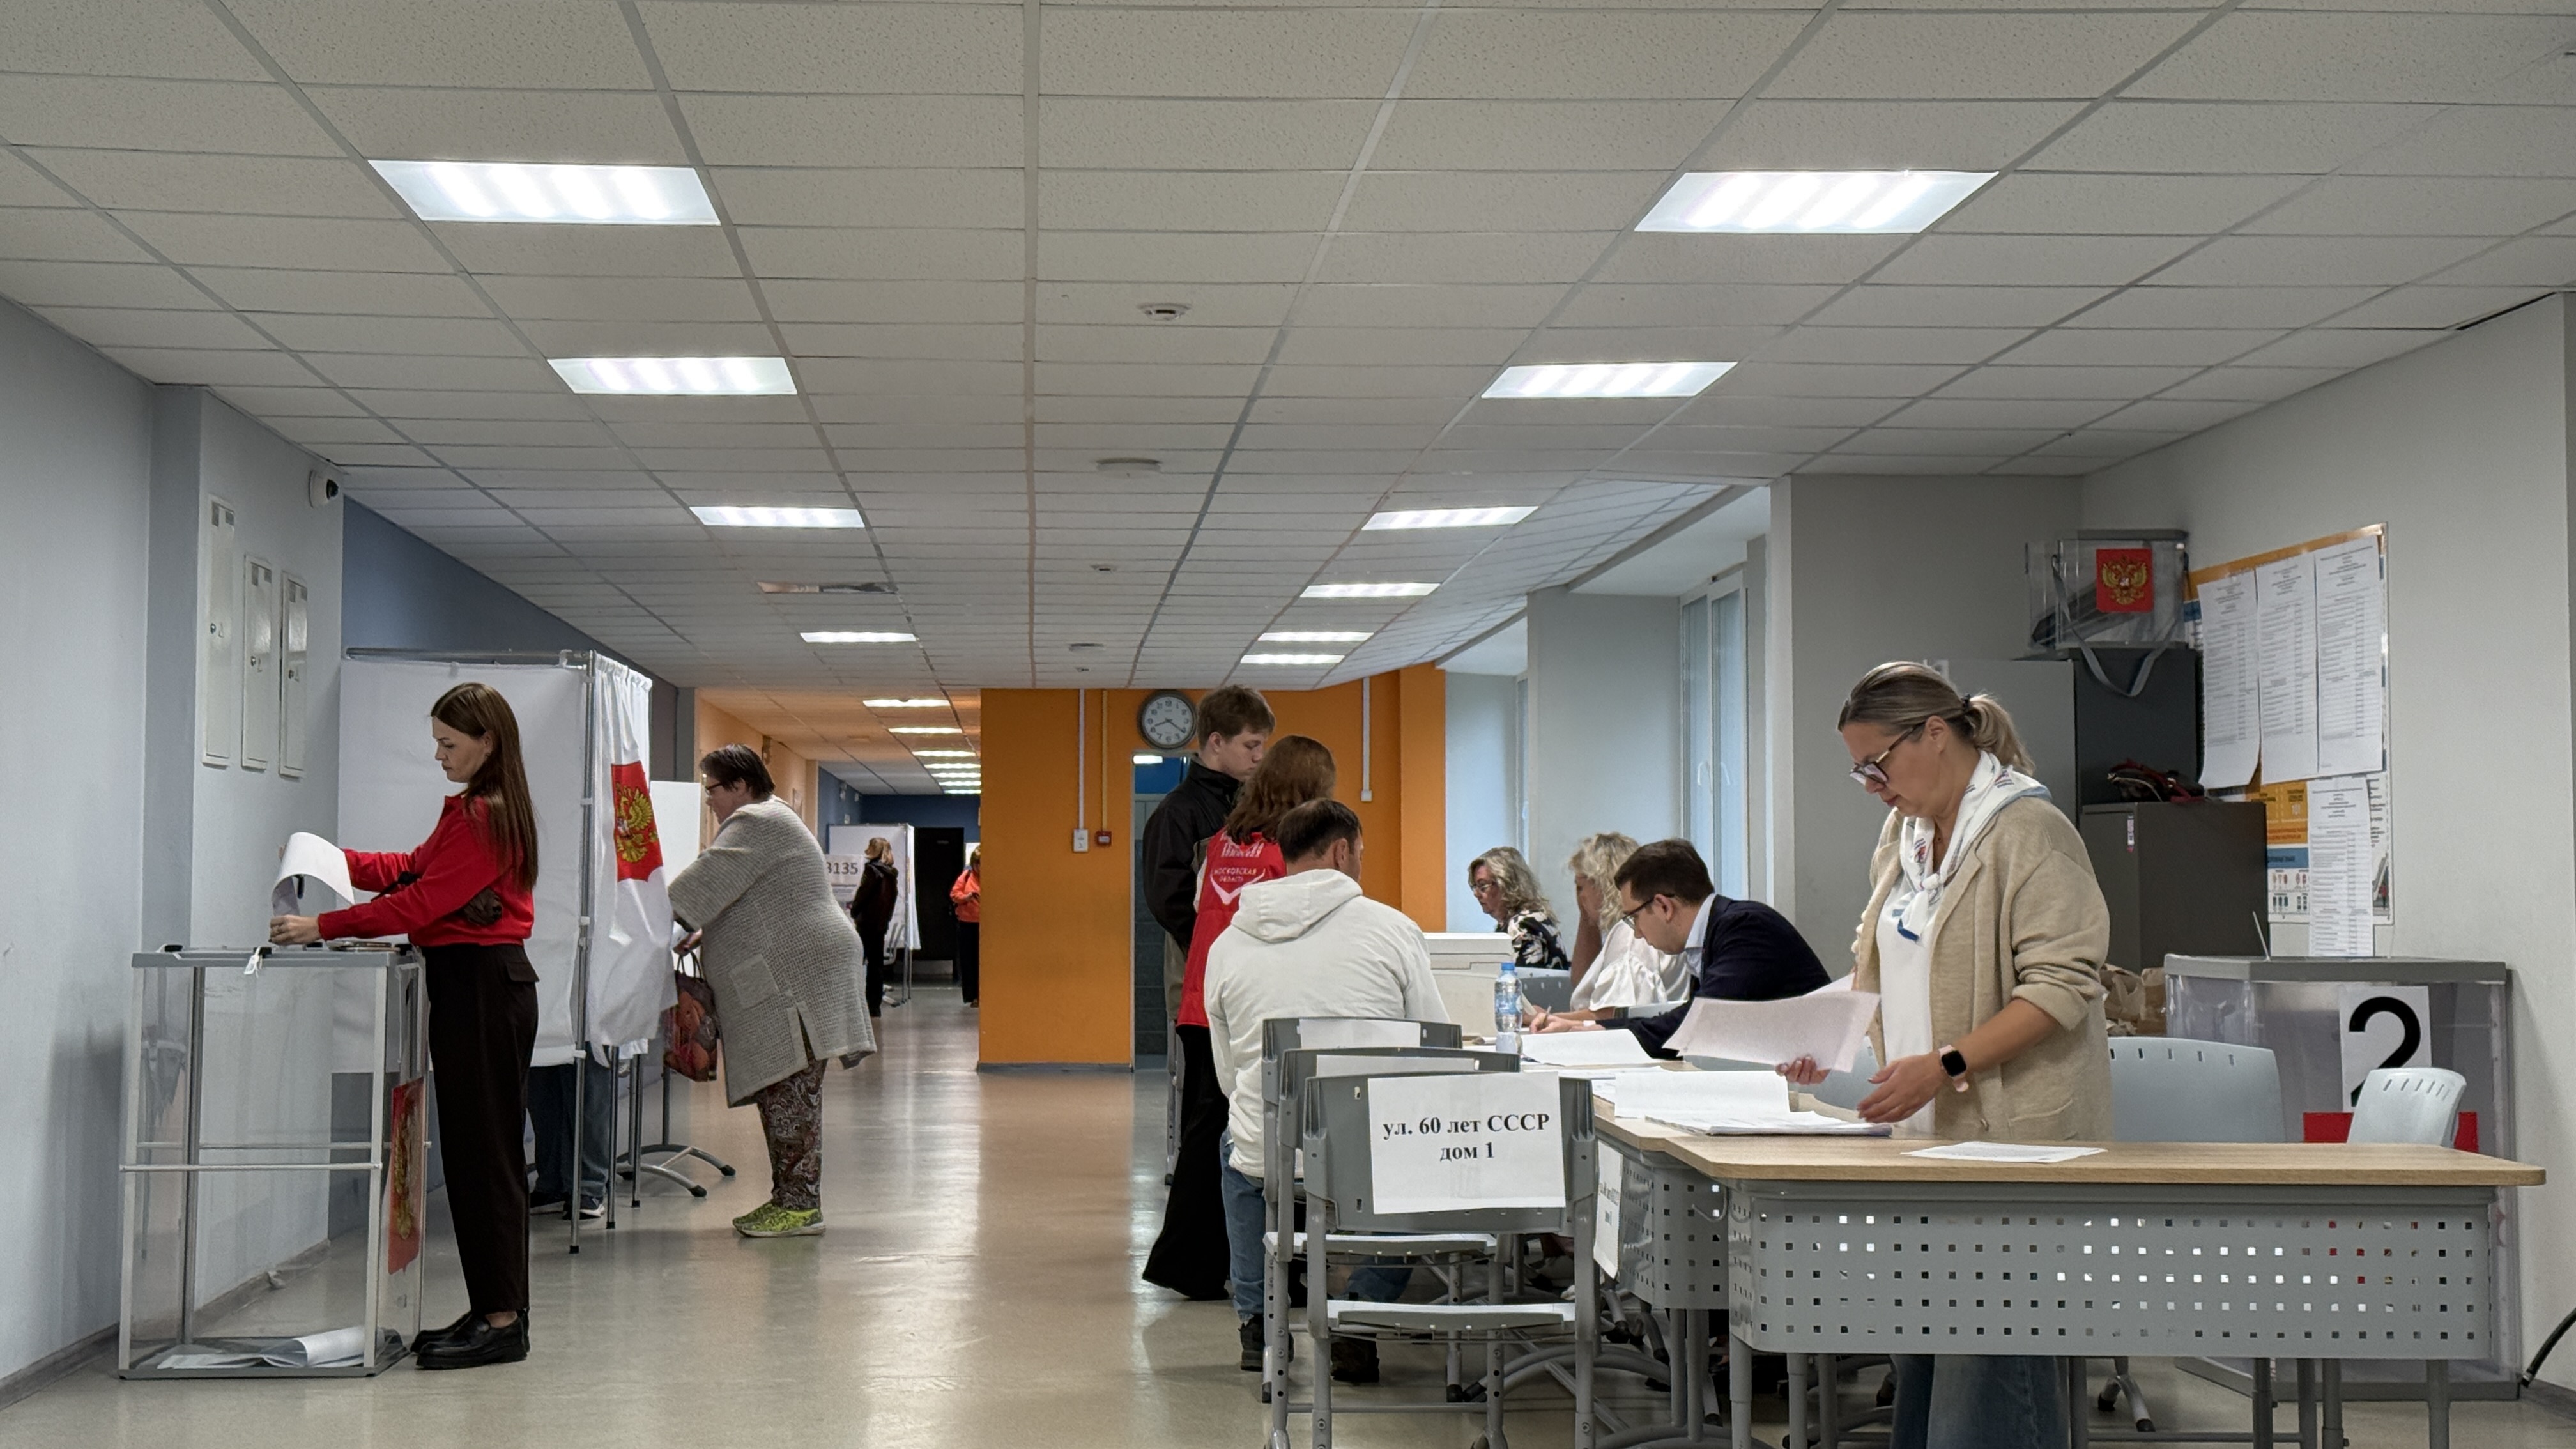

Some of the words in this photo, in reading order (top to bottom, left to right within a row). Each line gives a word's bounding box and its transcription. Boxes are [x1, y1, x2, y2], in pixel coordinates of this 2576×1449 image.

[2349, 997, 2421, 1107] 2
[1383, 1123, 1413, 1140] ул.
[1419, 1117, 1441, 1134] 60
[1447, 1120, 1481, 1133] лет
[1487, 1114, 1549, 1132] СССР
[1439, 1146, 1478, 1162] дом
[1485, 1142, 1494, 1158] 1
